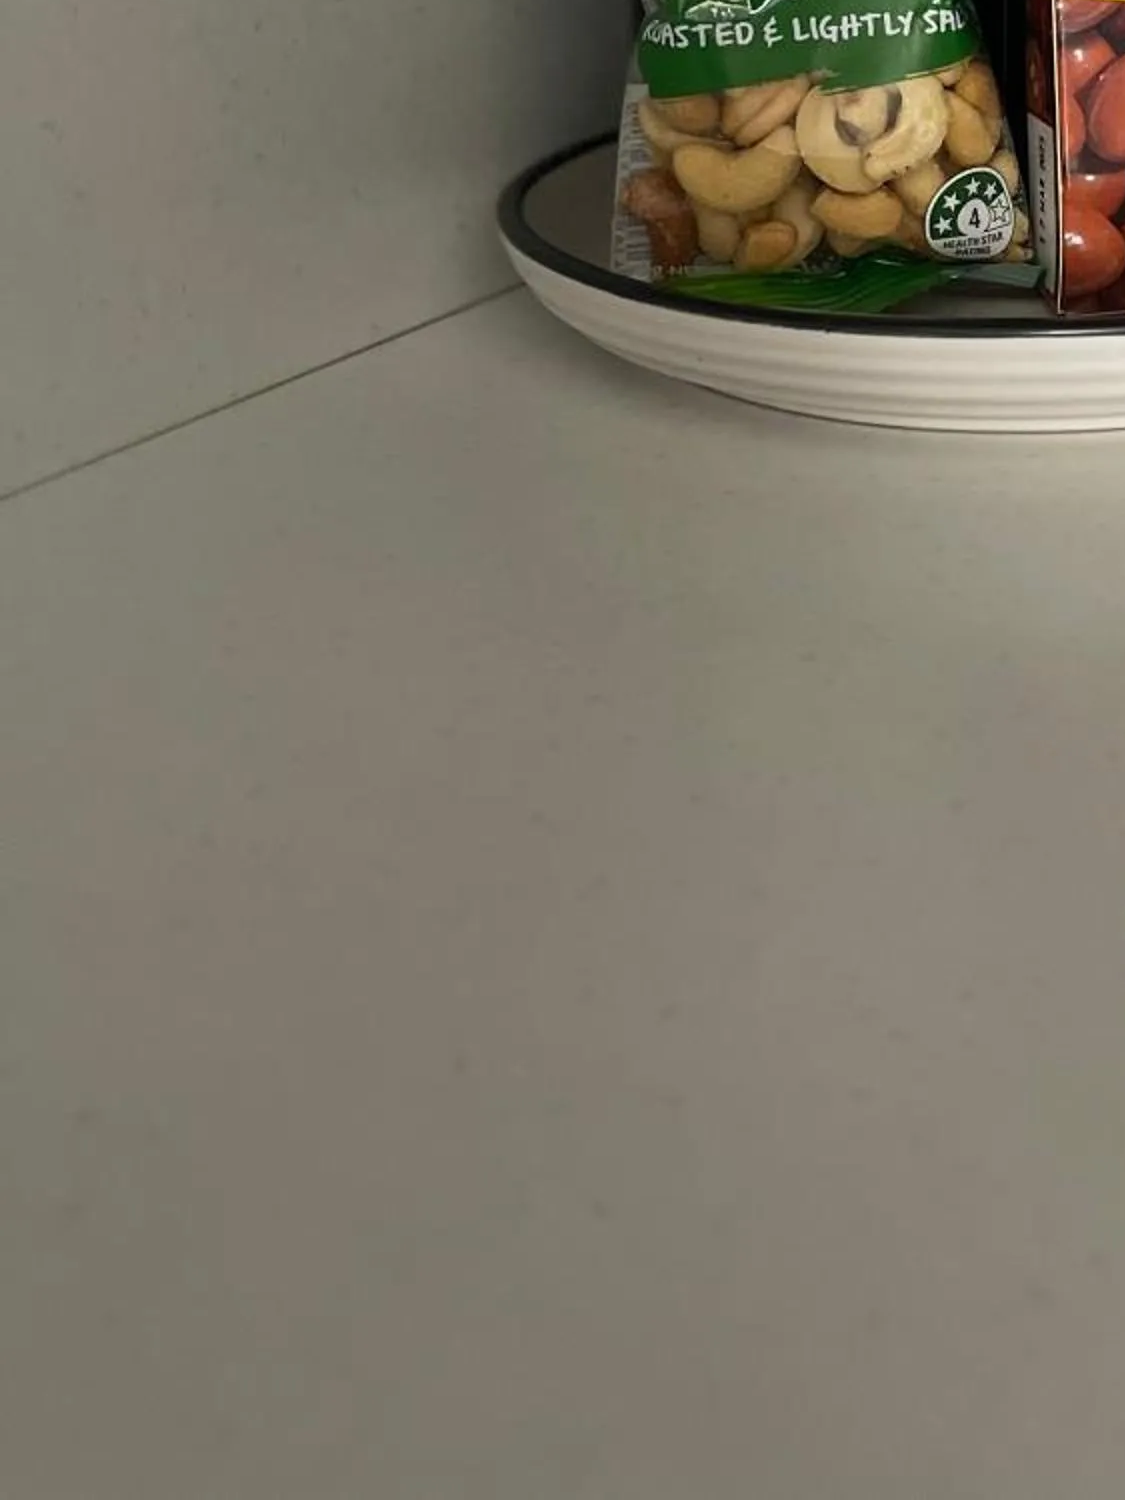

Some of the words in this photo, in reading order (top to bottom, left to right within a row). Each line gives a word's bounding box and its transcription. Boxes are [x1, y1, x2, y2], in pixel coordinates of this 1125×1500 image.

[792, 11, 914, 43] LIGHTLY
[923, 8, 965, 34] SAL
[969, 207, 981, 229] 4
